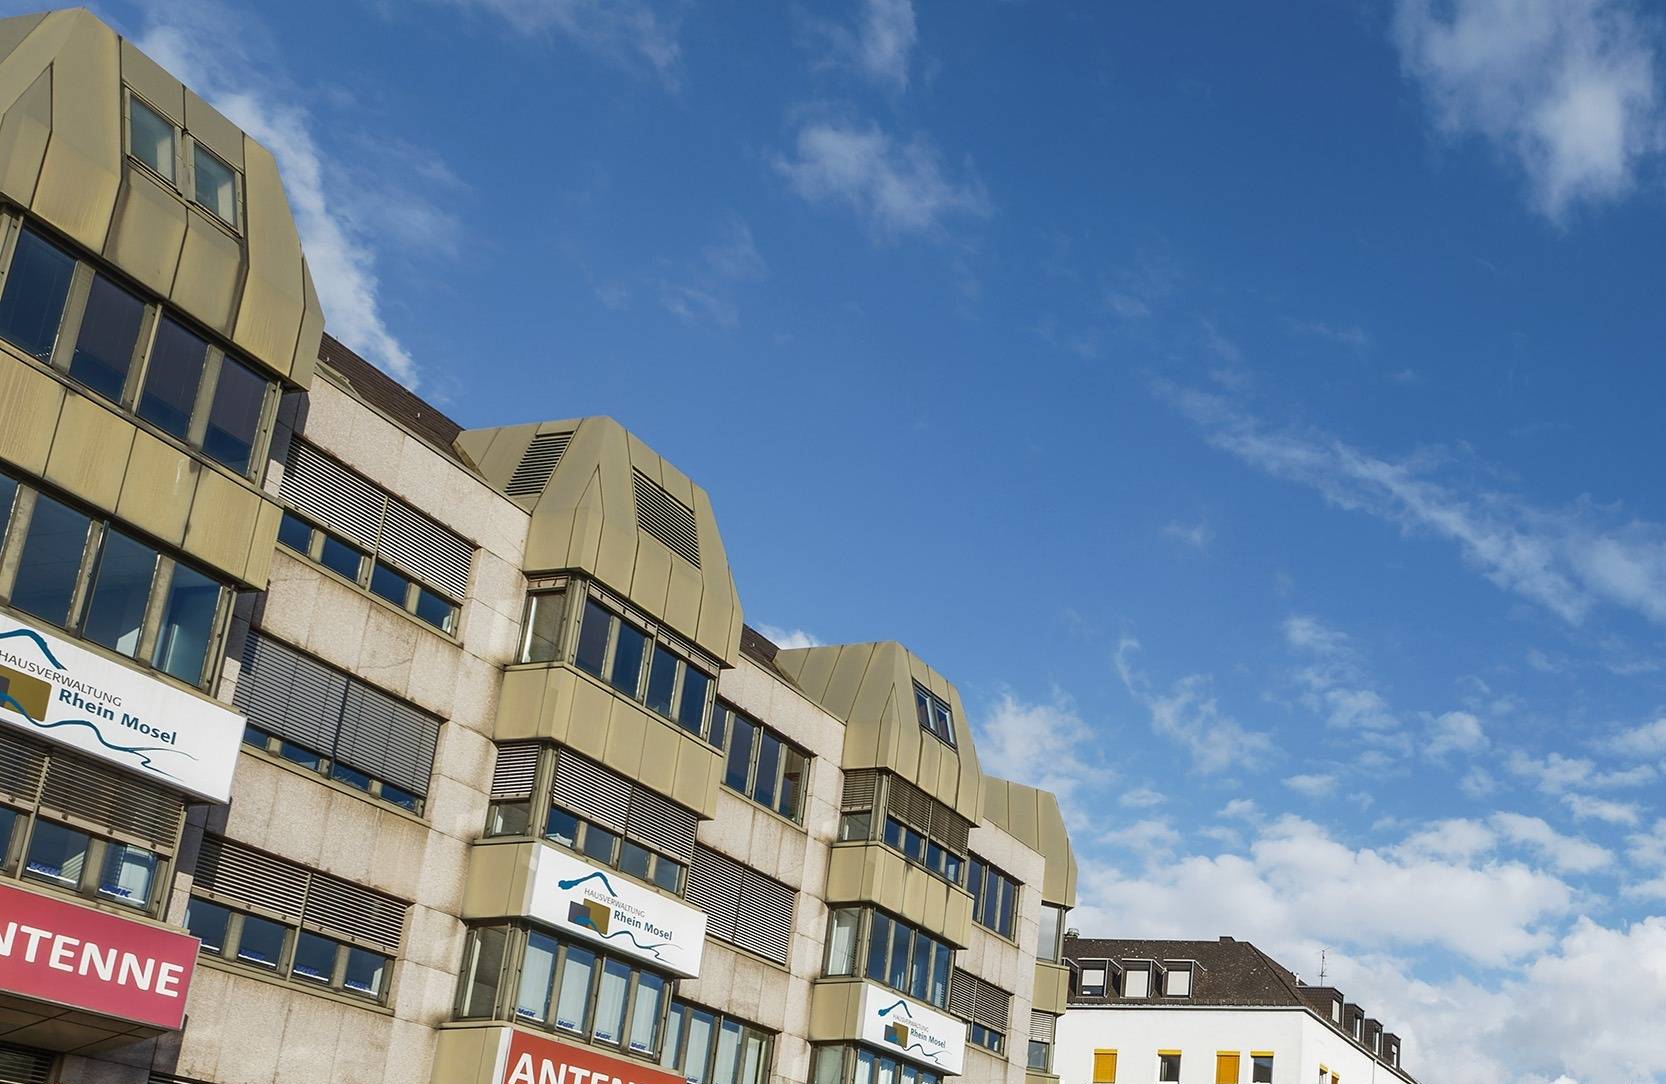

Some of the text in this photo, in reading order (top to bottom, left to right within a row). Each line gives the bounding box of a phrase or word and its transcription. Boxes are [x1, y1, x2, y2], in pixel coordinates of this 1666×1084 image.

[0, 650, 122, 707] HAUSVERWALTUNG
[58, 687, 178, 745] Rhein Mosel
[584, 887, 645, 918] HAUSVERWALTUNG
[613, 909, 673, 941] Rhein Mosel
[910, 1028, 946, 1048] Rhein Mosel
